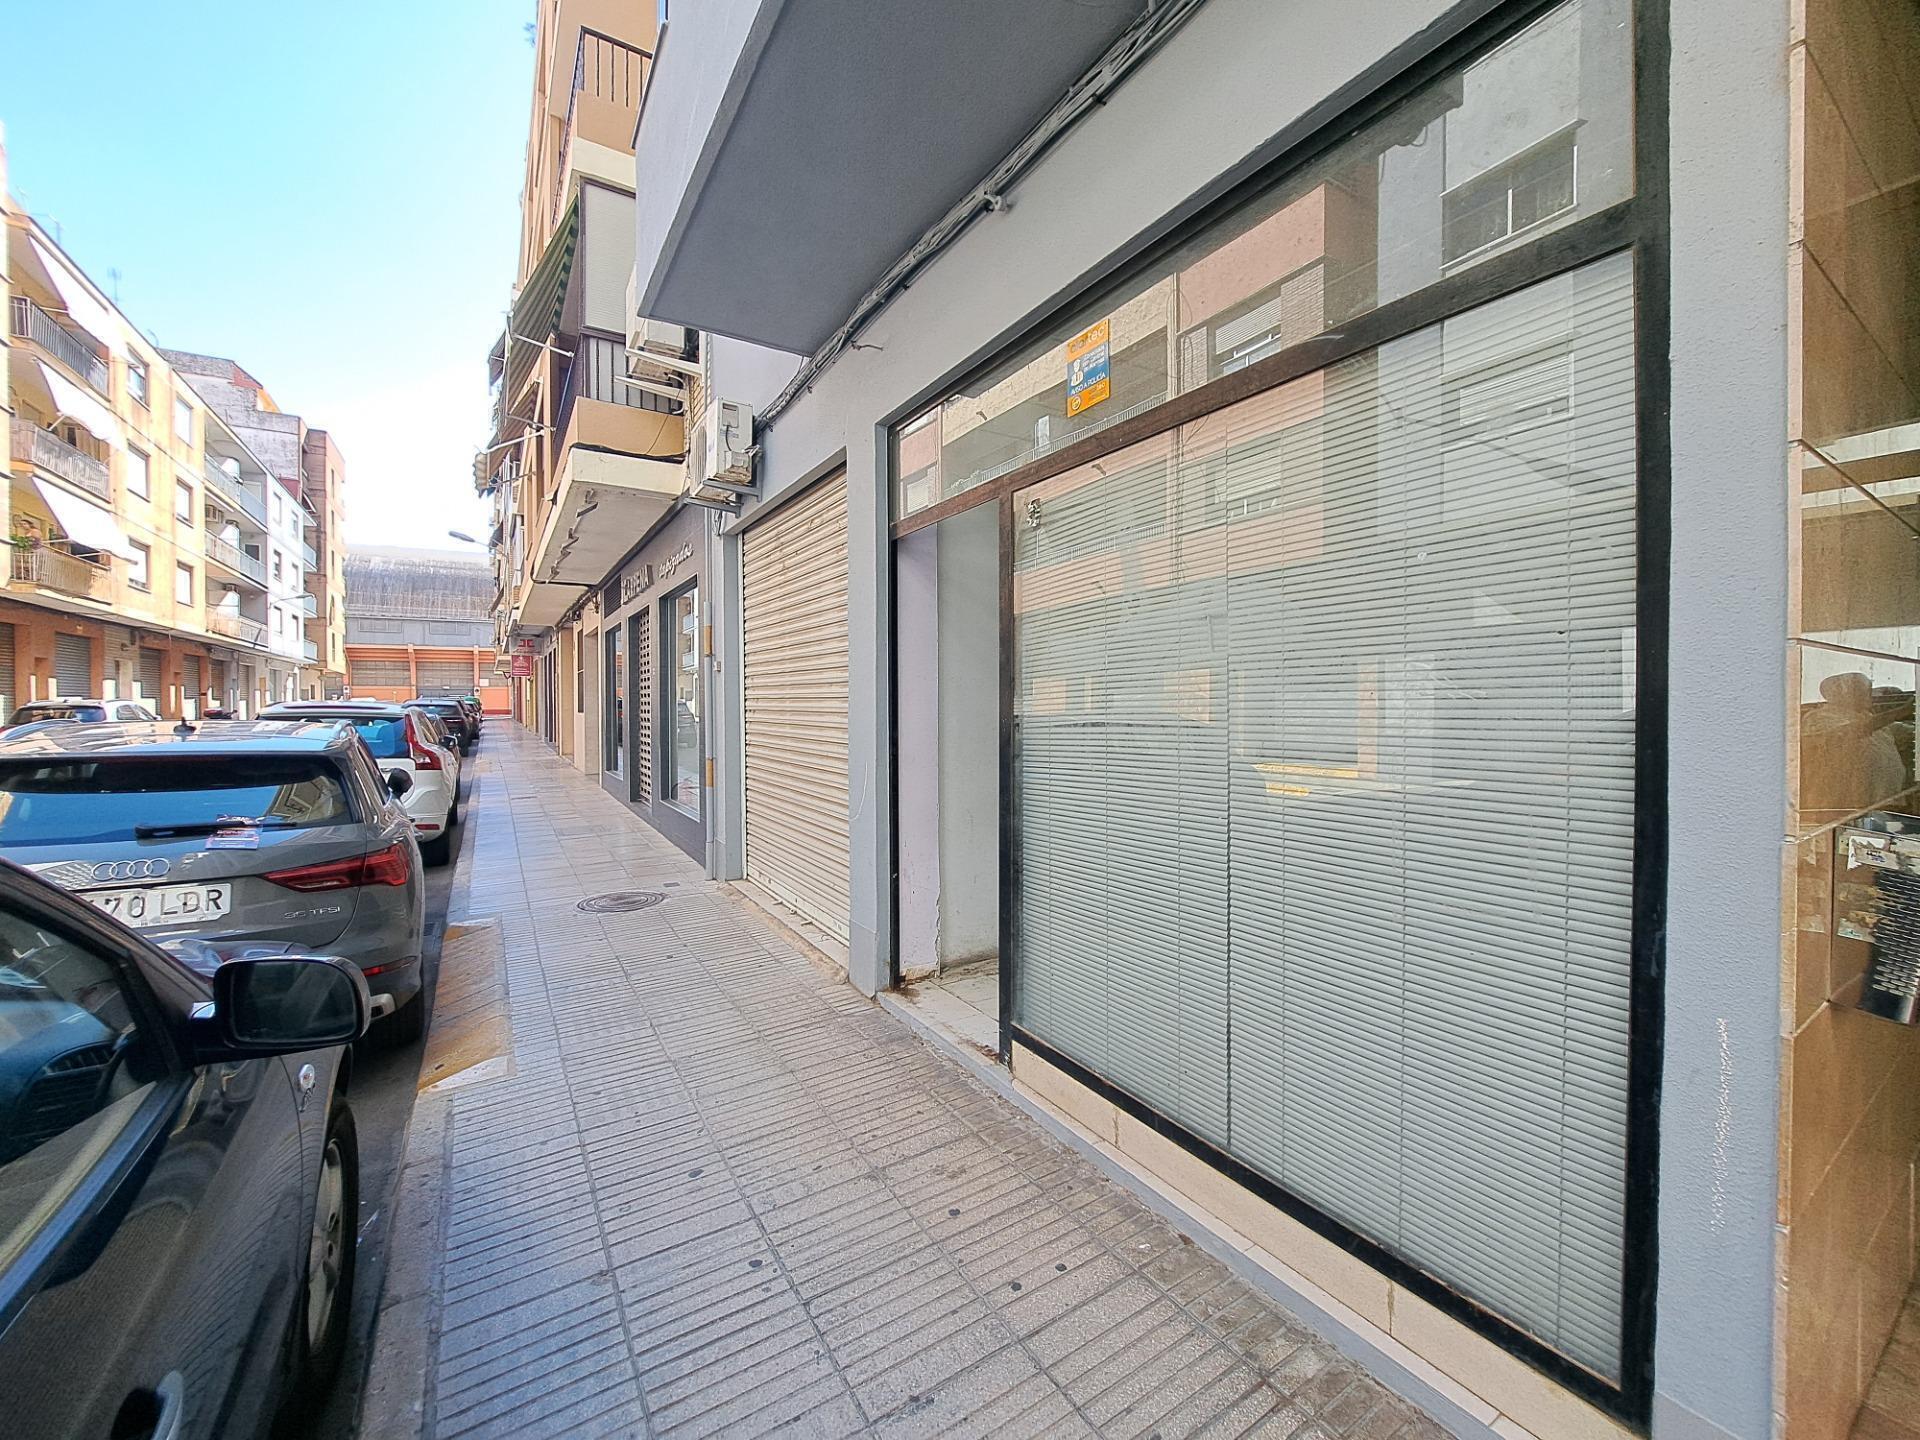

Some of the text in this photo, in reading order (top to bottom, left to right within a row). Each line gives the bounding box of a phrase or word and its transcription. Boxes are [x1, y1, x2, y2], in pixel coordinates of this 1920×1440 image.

[87, 889, 222, 918] 70 LDR
[309, 906, 341, 916] TFSI
